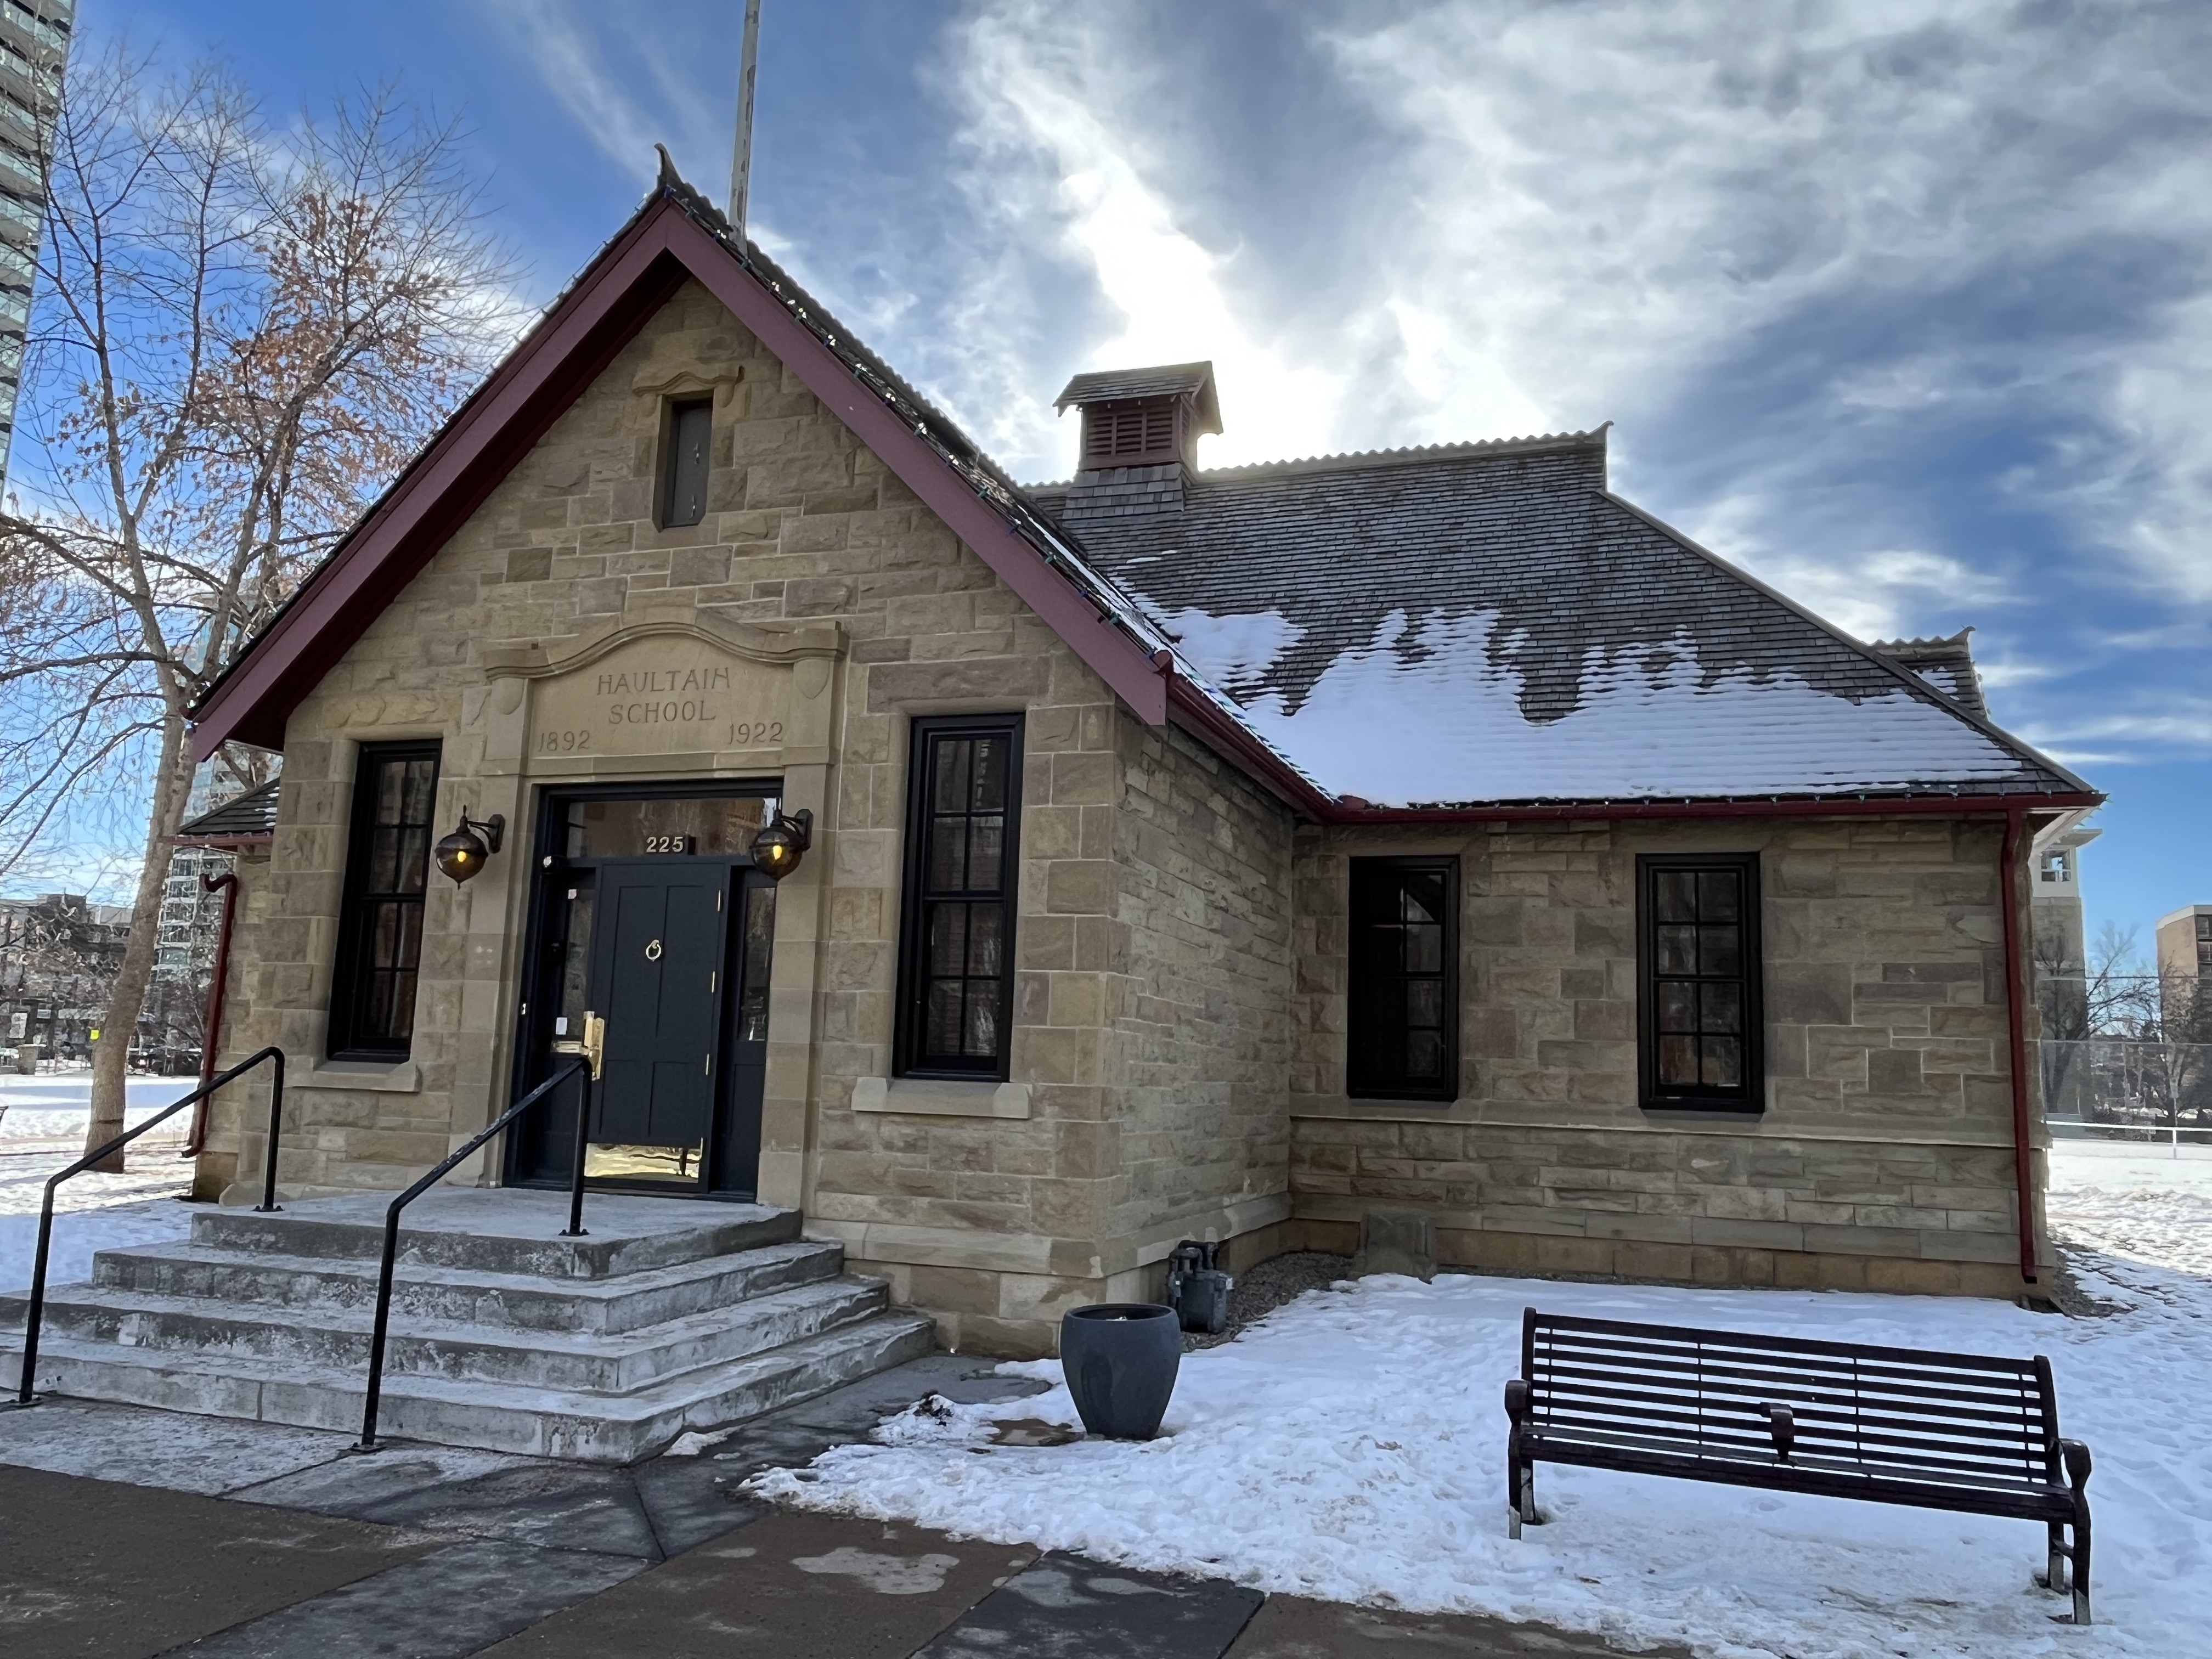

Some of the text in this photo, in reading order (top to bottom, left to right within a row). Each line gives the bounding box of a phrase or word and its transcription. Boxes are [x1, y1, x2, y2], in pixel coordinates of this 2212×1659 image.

[608, 699, 716, 724] SCHOOL
[537, 730, 590, 752] 1892
[727, 721, 783, 745] 1922
[646, 836, 684, 853] 225
